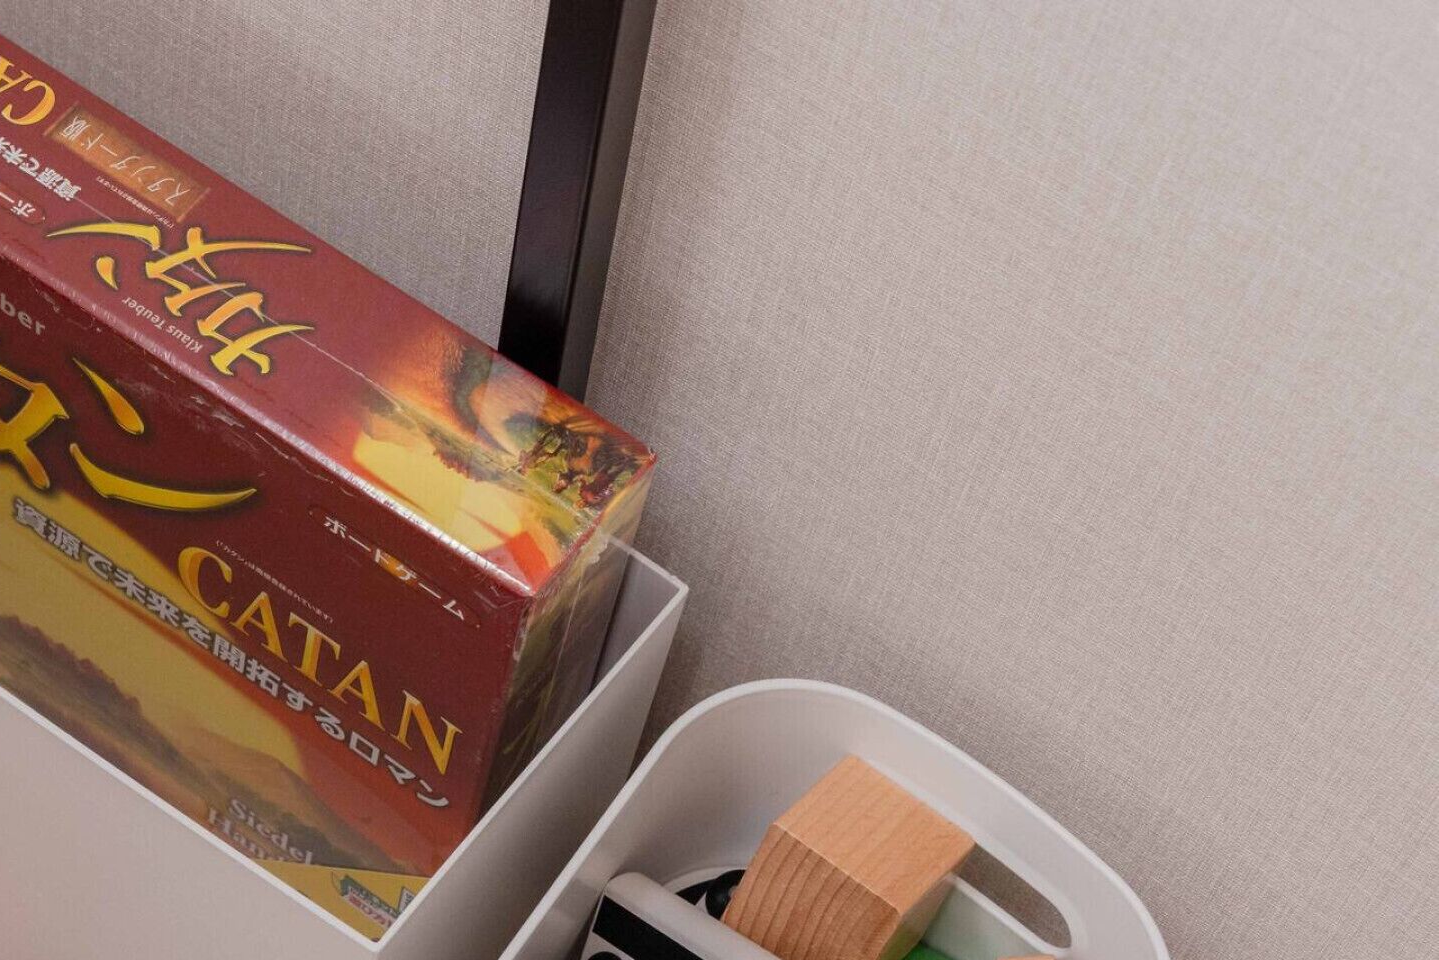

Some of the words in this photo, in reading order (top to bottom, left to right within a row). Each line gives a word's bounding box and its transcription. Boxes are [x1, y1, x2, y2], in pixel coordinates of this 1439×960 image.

[59, 115, 191, 207] スタンダード版
[45, 222, 316, 377] カタン
[121, 295, 165, 330] Teuber
[166, 325, 204, 354] Klaus
[323, 514, 466, 622] ボードゲーム
[13, 498, 450, 809] 資源で未来を開拓するロマン
[177, 546, 464, 776] CATAN
